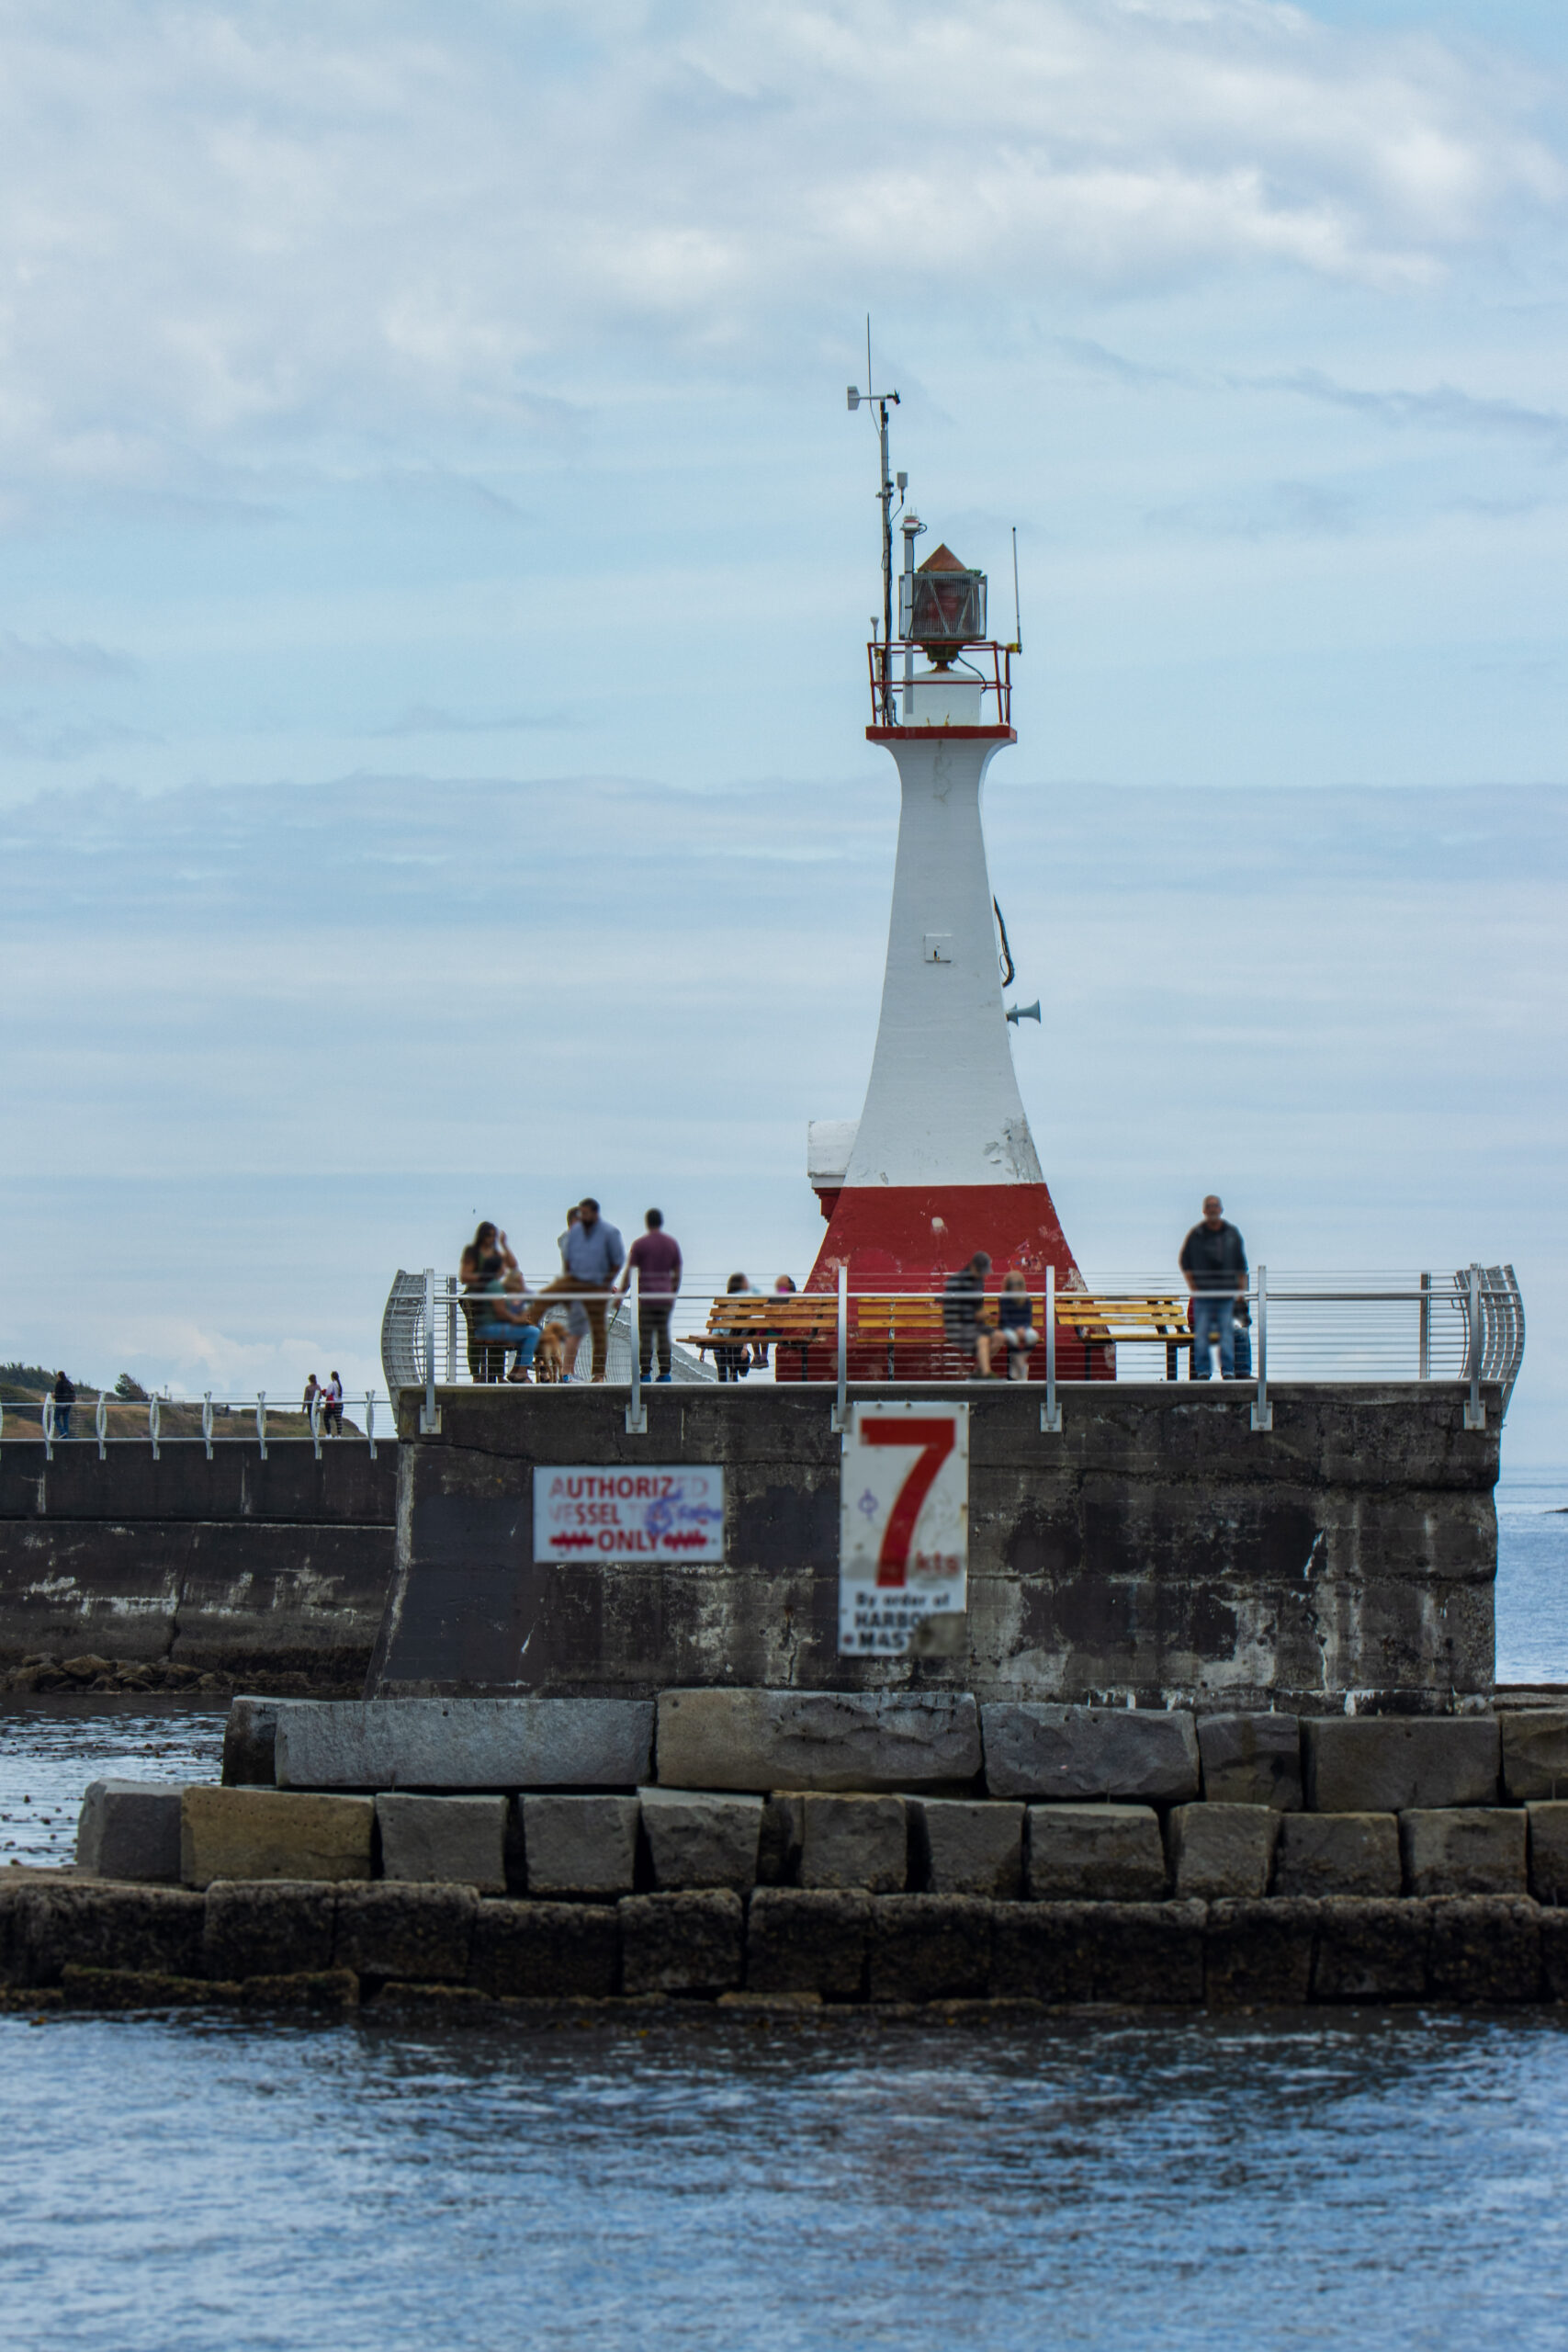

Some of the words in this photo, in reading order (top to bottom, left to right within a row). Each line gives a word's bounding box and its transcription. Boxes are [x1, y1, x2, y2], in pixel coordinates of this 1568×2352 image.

[548, 1476, 708, 1498] AUTHORIZED
[548, 1502, 621, 1525] VESSEL
[859, 1418, 955, 1587] 7
[915, 1550, 960, 1575] kts
[598, 1529, 660, 1552] ONLY
[855, 1591, 876, 1608] By
[883, 1592, 925, 1607] order
[932, 1592, 950, 1607] of
